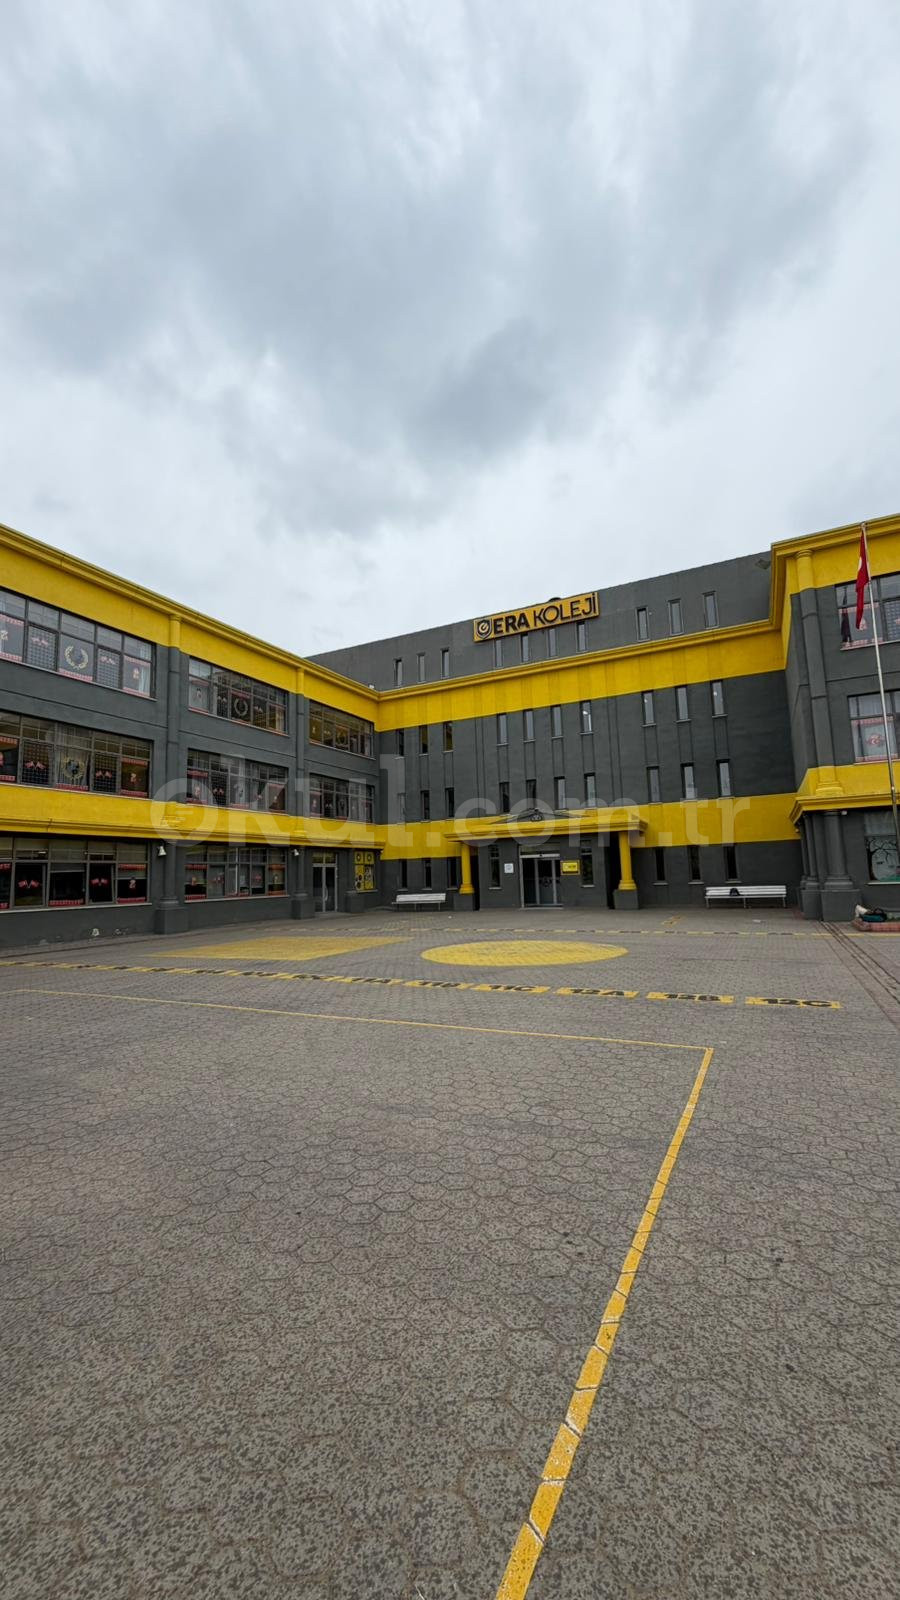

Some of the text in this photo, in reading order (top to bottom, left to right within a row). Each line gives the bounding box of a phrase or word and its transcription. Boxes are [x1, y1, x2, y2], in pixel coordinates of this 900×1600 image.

[493, 592, 597, 634] ERA KOLEJİ
[570, 988, 625, 996] 12A
[762, 998, 832, 1007] 12C
